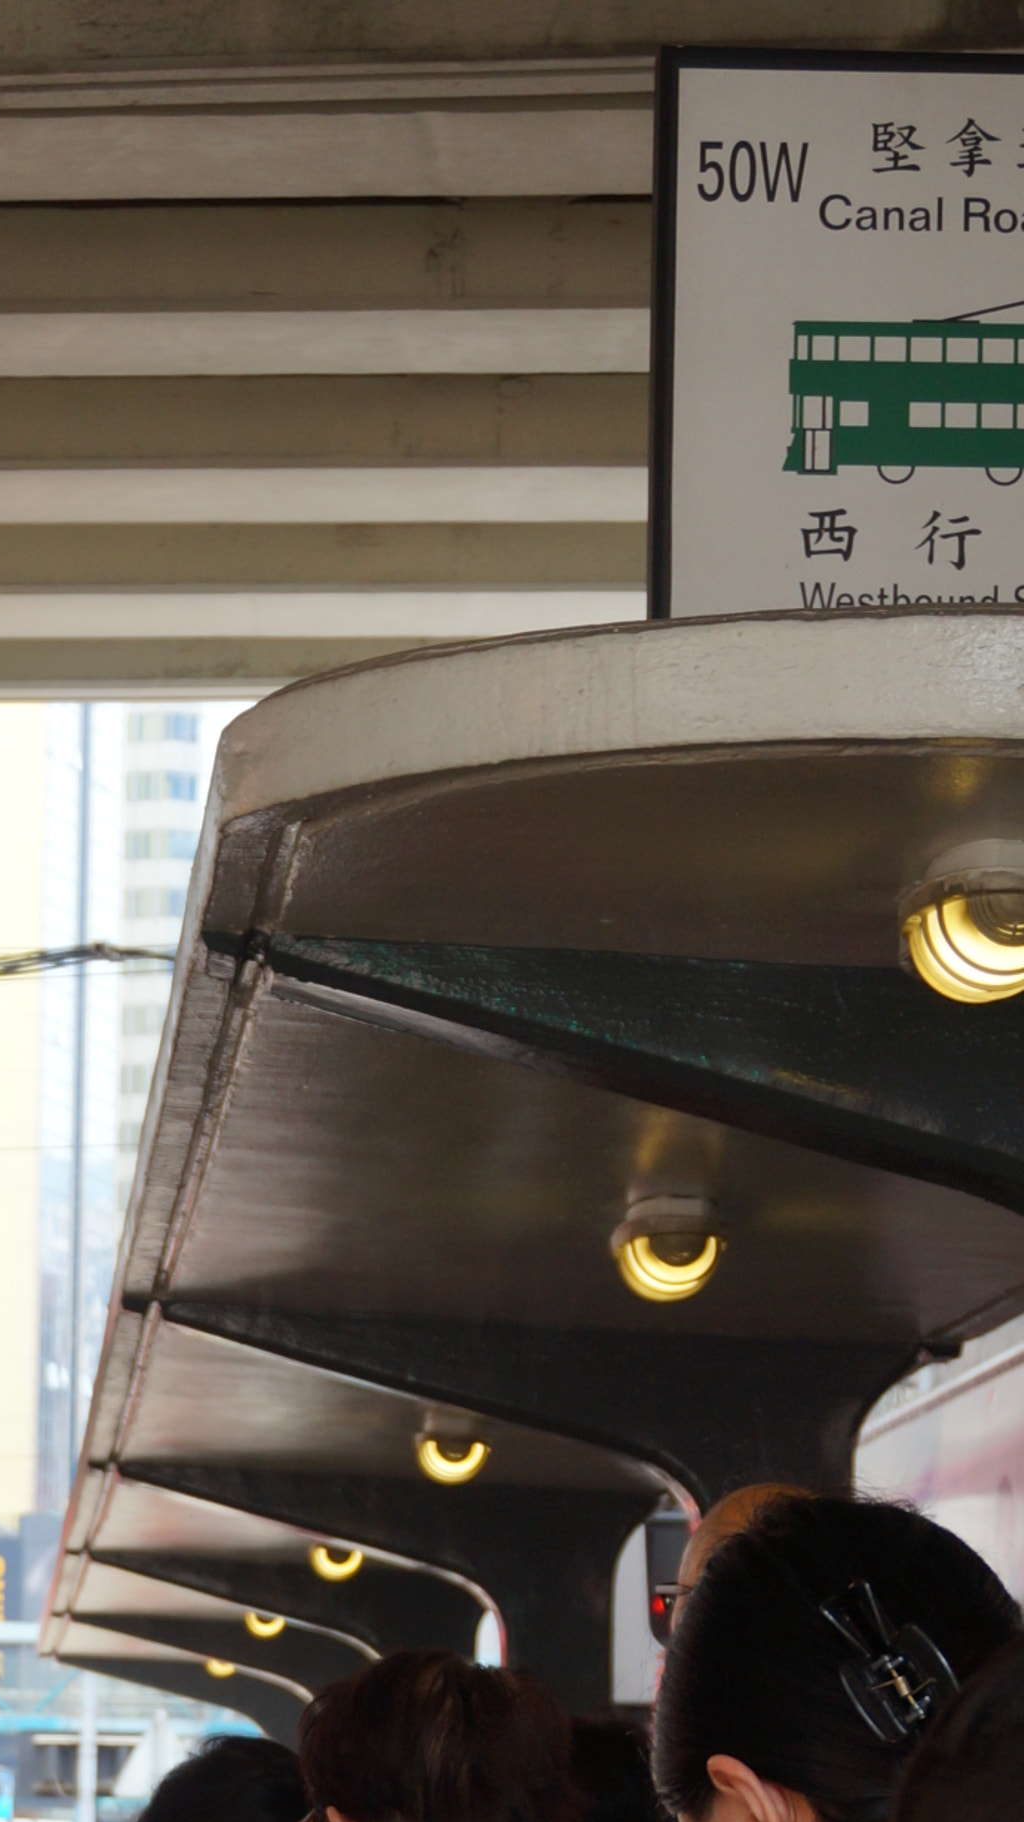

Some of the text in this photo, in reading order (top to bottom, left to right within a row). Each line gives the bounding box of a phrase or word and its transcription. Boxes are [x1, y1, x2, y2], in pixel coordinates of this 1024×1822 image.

[697, 141, 809, 203] 50W
[872, 118, 1024, 178] 堅拿
[819, 194, 1024, 234] Canal Ro
[801, 508, 982, 570] 西行
